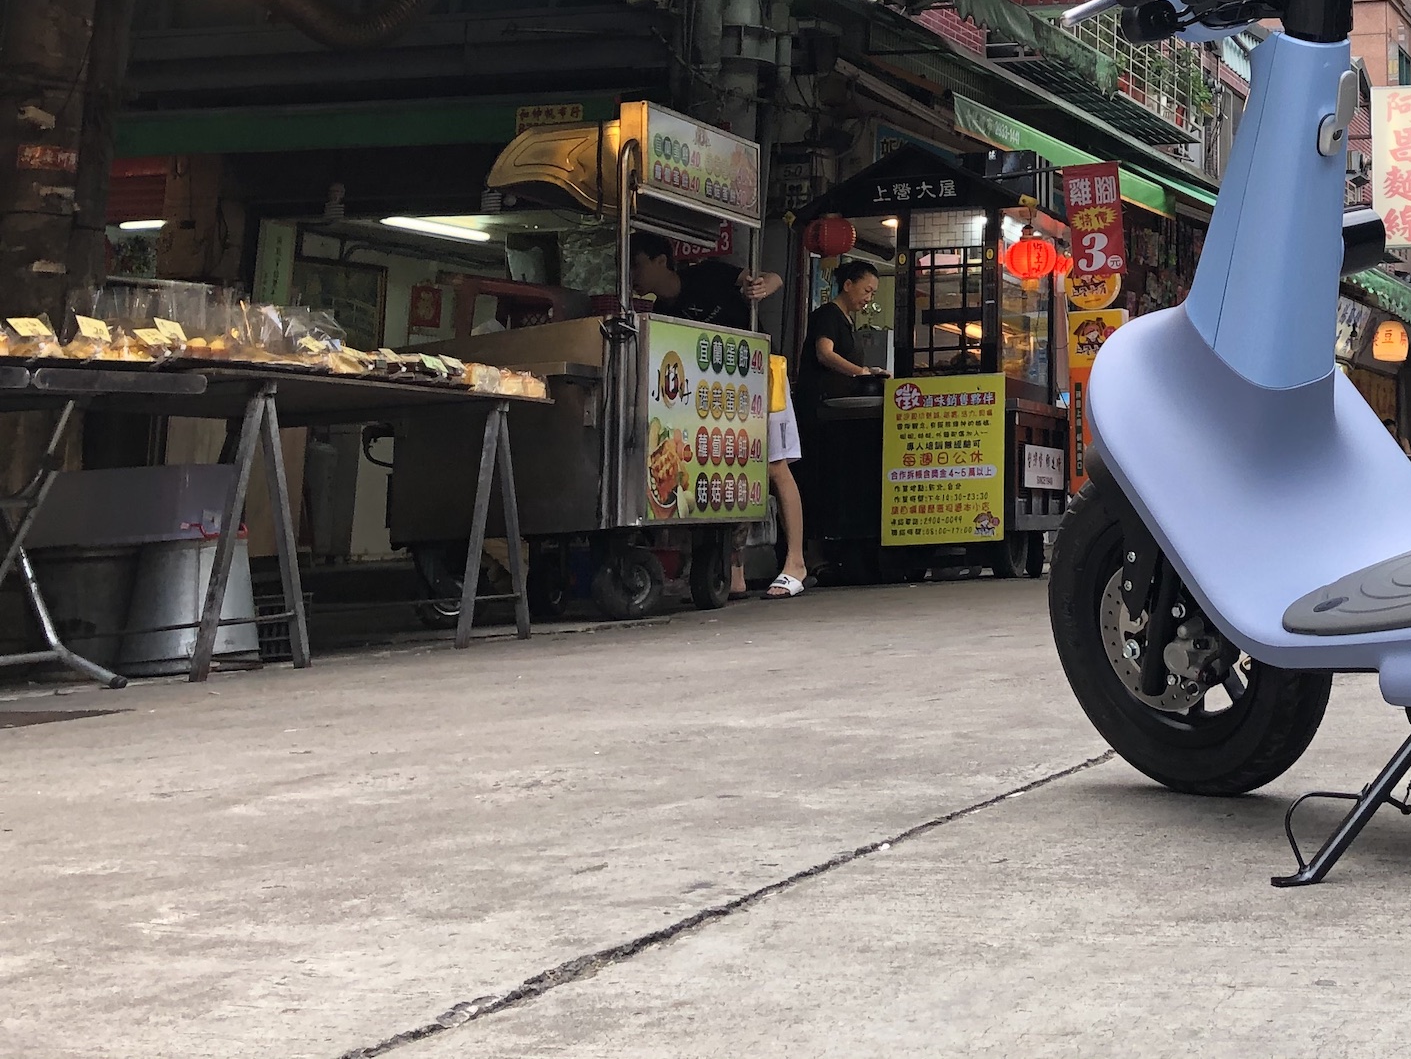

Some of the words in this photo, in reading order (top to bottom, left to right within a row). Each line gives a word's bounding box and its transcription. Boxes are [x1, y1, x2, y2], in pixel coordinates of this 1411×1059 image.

[1069, 176, 1117, 206] 雞腳
[1078, 232, 1109, 272] 3
[1109, 256, 1122, 268] 元
[699, 339, 749, 370] 宜蘭蛋餅
[751, 348, 762, 370] 40
[698, 435, 746, 459] 蘿蔔蛋餅
[902, 451, 984, 466] 每週日公休
[698, 479, 746, 503] 菇菇蛋餅
